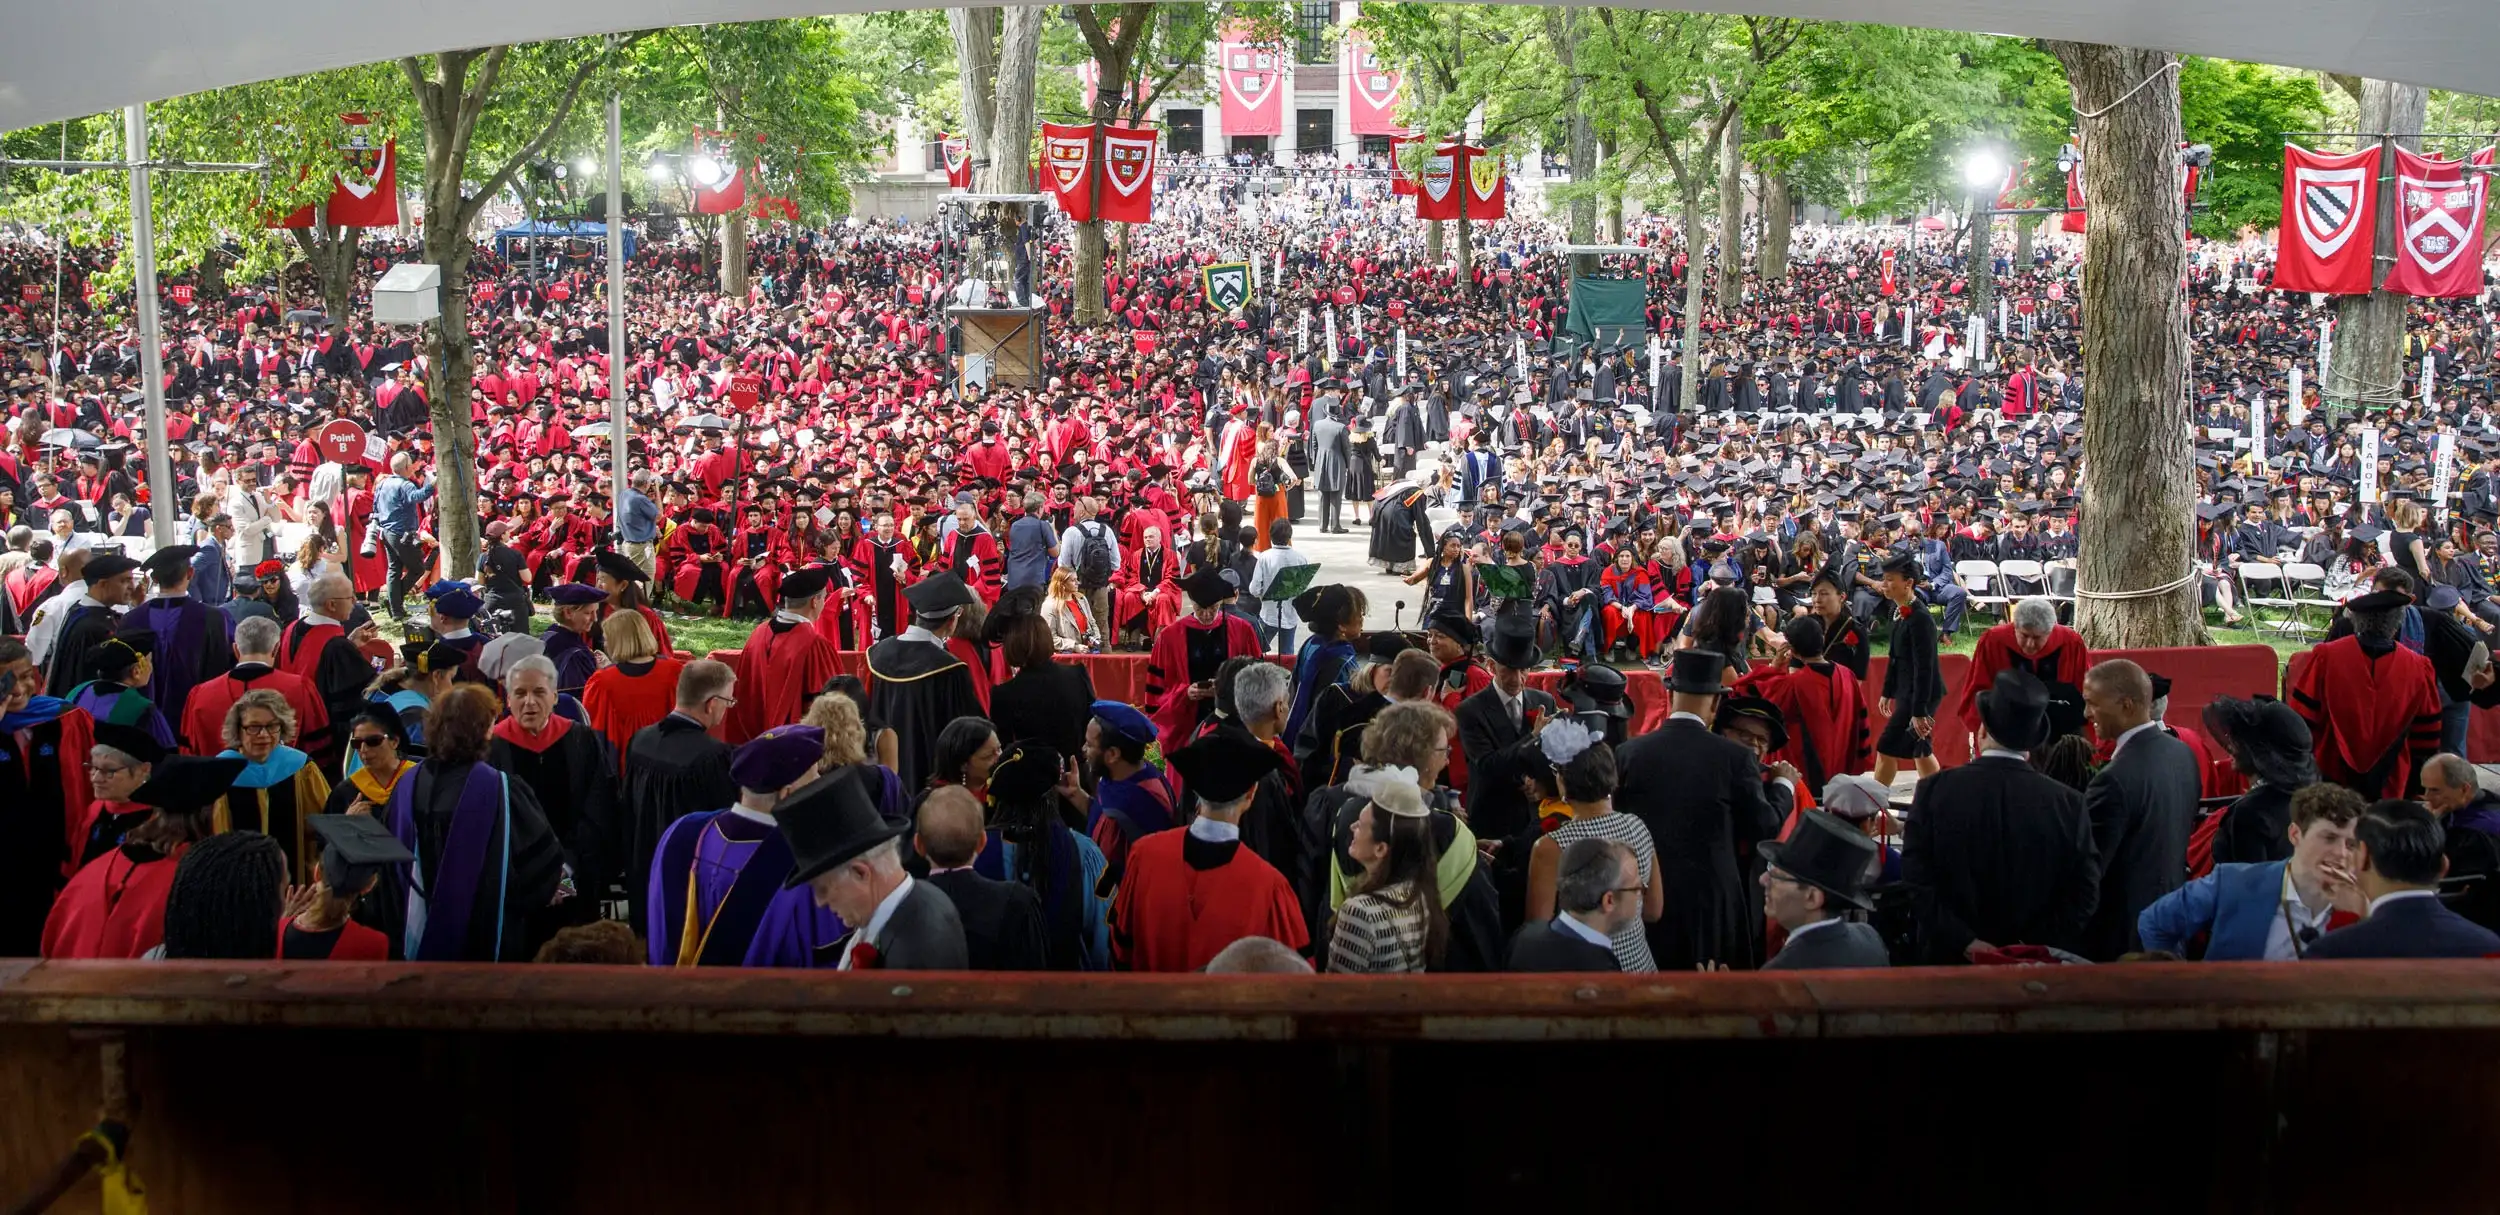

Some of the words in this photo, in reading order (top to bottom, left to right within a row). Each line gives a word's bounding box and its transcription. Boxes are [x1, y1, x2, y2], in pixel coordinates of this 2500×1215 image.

[1135, 333, 1154, 342] GSAS
[732, 382, 758, 393] GSAS
[330, 432, 356, 442] Point
[339, 442, 348, 452] B
[2365, 442, 2374, 489] CABOT
[2434, 453, 2445, 492] CABOT
